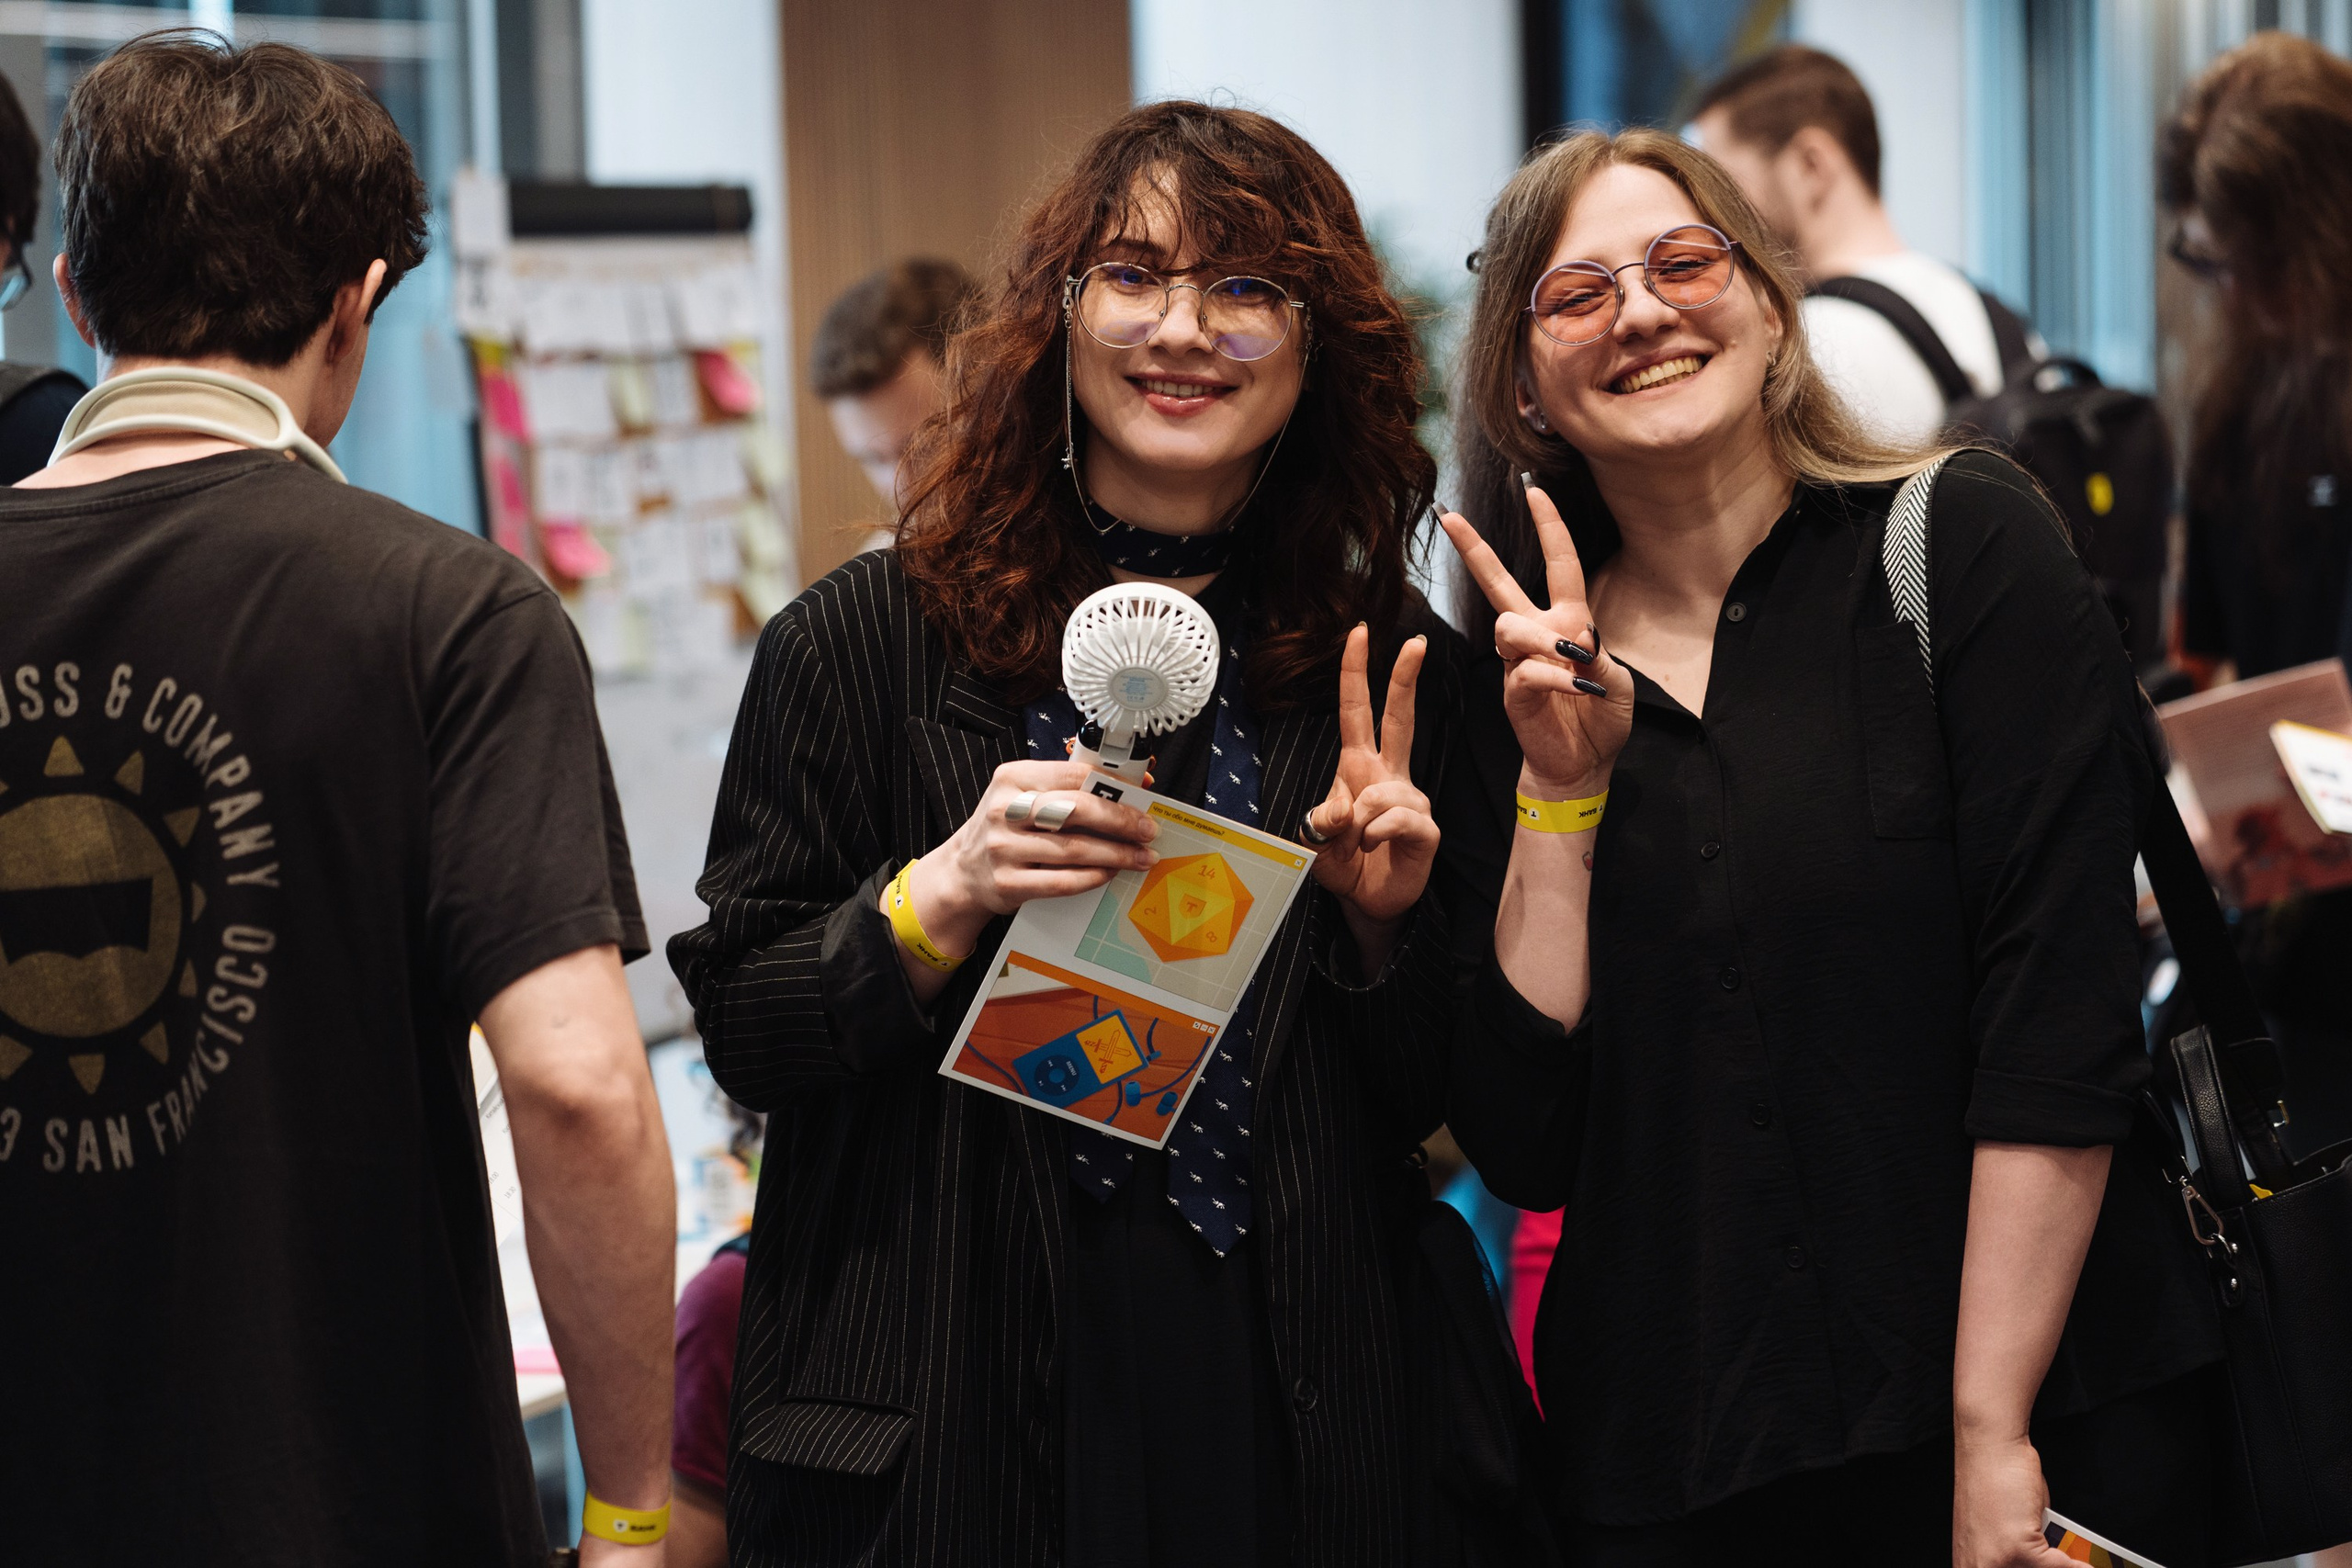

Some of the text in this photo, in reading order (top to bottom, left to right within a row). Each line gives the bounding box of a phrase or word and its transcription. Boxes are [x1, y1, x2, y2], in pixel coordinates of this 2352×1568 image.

[104, 662, 133, 719] &
[141, 676, 280, 889] COMPANY
[1578, 807, 1598, 818] БАНК
[1153, 806, 1162, 814] Что
[1171, 812, 1183, 821] обо
[1183, 818, 1196, 826] мне
[1195, 821, 1226, 837] думаешь?
[1197, 864, 1216, 880] 14
[1144, 907, 1157, 916] 2
[1206, 931, 1217, 943] 8
[42, 1113, 135, 1173] SAN
[146, 924, 276, 1157] FRANCISCO
[1066, 1060, 1077, 1076] MENU
